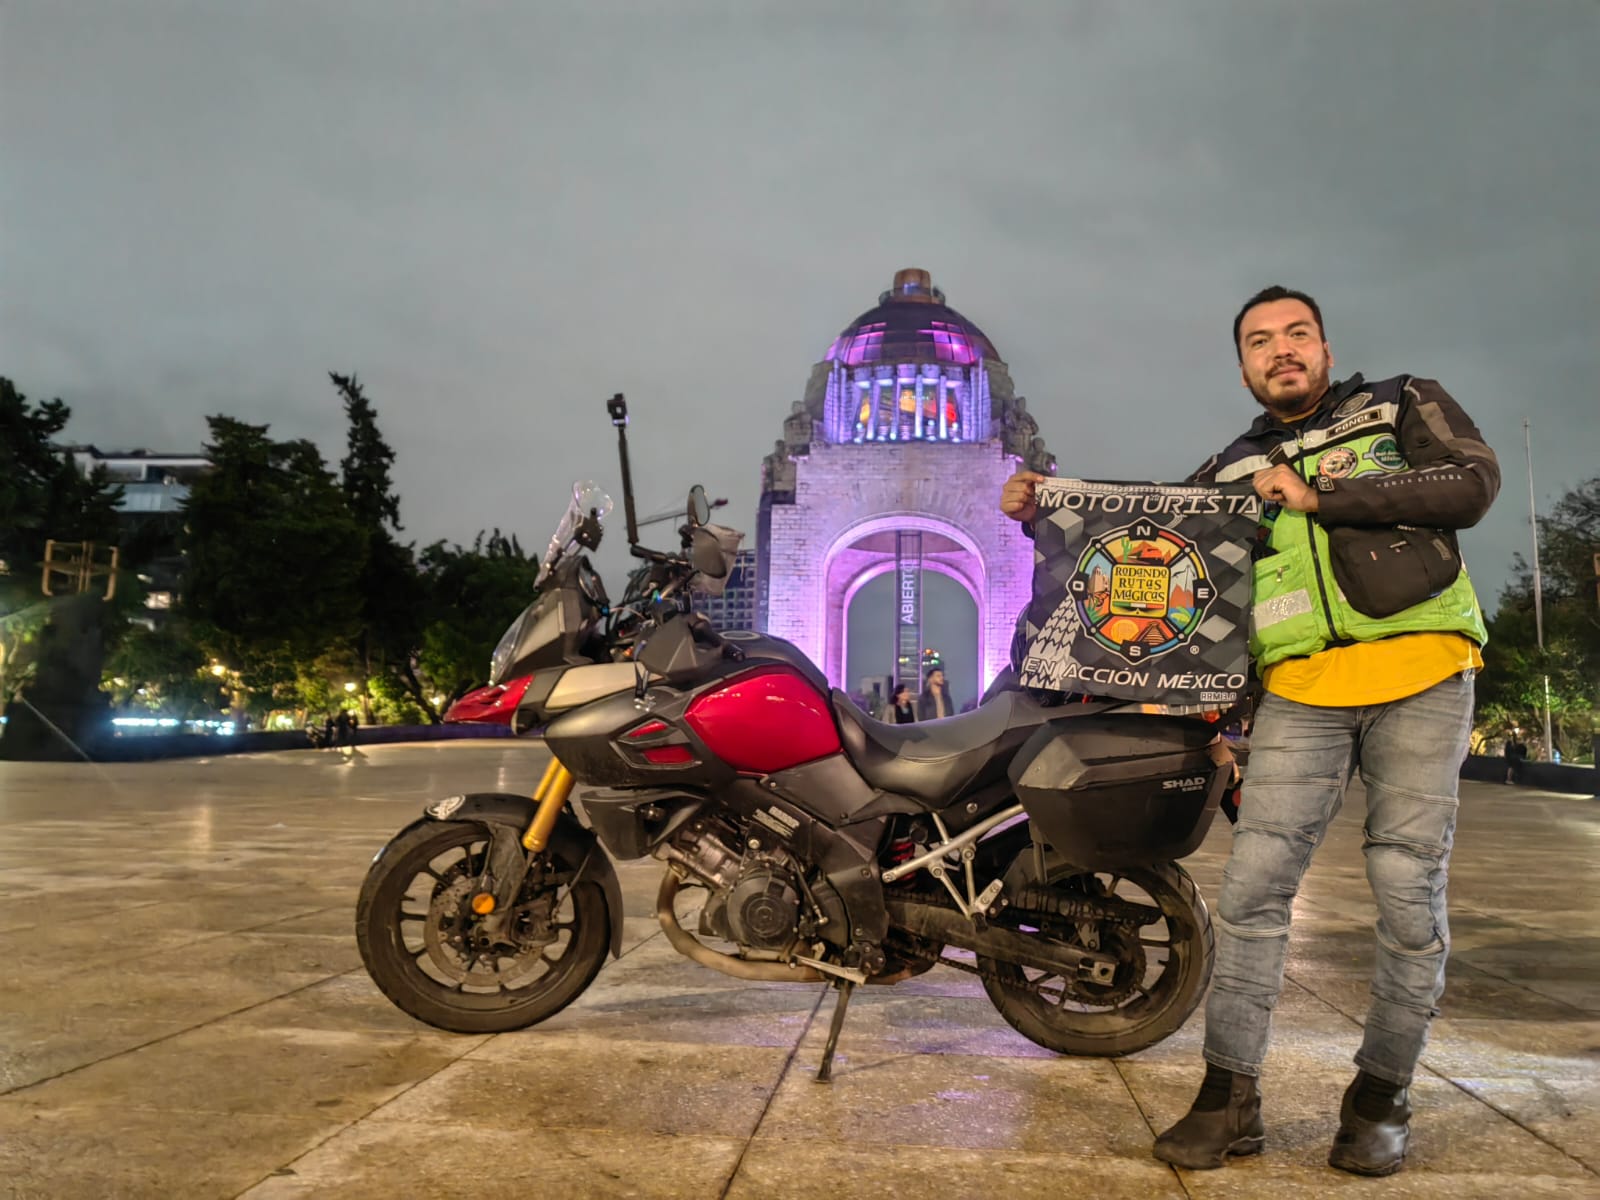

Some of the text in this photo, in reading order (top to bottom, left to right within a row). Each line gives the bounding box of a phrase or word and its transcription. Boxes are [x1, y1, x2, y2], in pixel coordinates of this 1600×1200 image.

[1334, 414, 1371, 433] PONCE
[1040, 489, 1258, 514] MOTOTURISTA
[1136, 526, 1151, 536] N
[1072, 581, 1085, 592] O
[1197, 588, 1209, 598] E
[1129, 646, 1141, 656] S
[1024, 658, 1245, 690] EN ACCIÓN MÉXICO
[1162, 777, 1206, 790] SHAD
